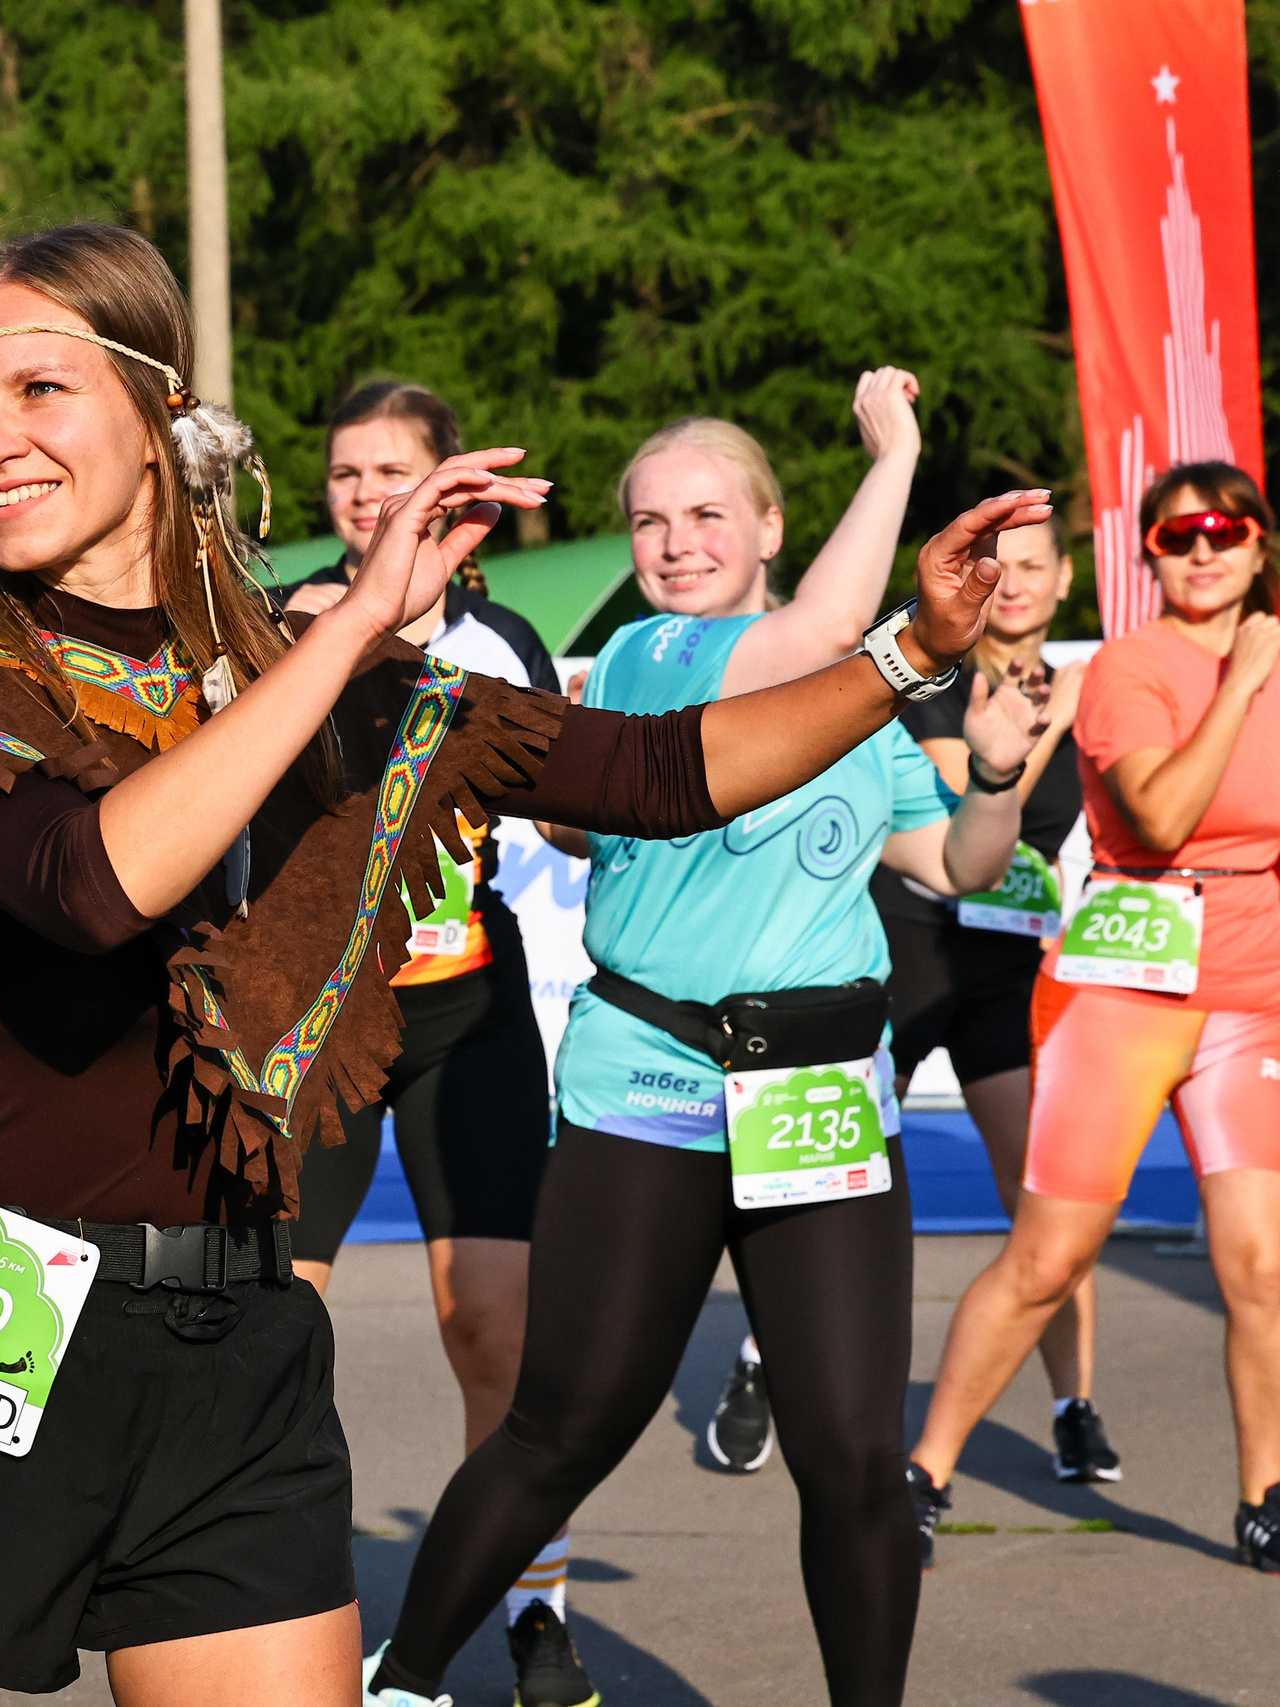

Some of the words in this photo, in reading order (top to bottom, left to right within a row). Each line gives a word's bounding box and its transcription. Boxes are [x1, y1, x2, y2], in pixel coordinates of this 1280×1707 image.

[1000, 870, 1043, 902] 091
[1082, 913, 1170, 952] 2043
[628, 1070, 701, 1094] забег
[626, 1090, 718, 1118] ночная
[767, 1105, 862, 1152] 2135
